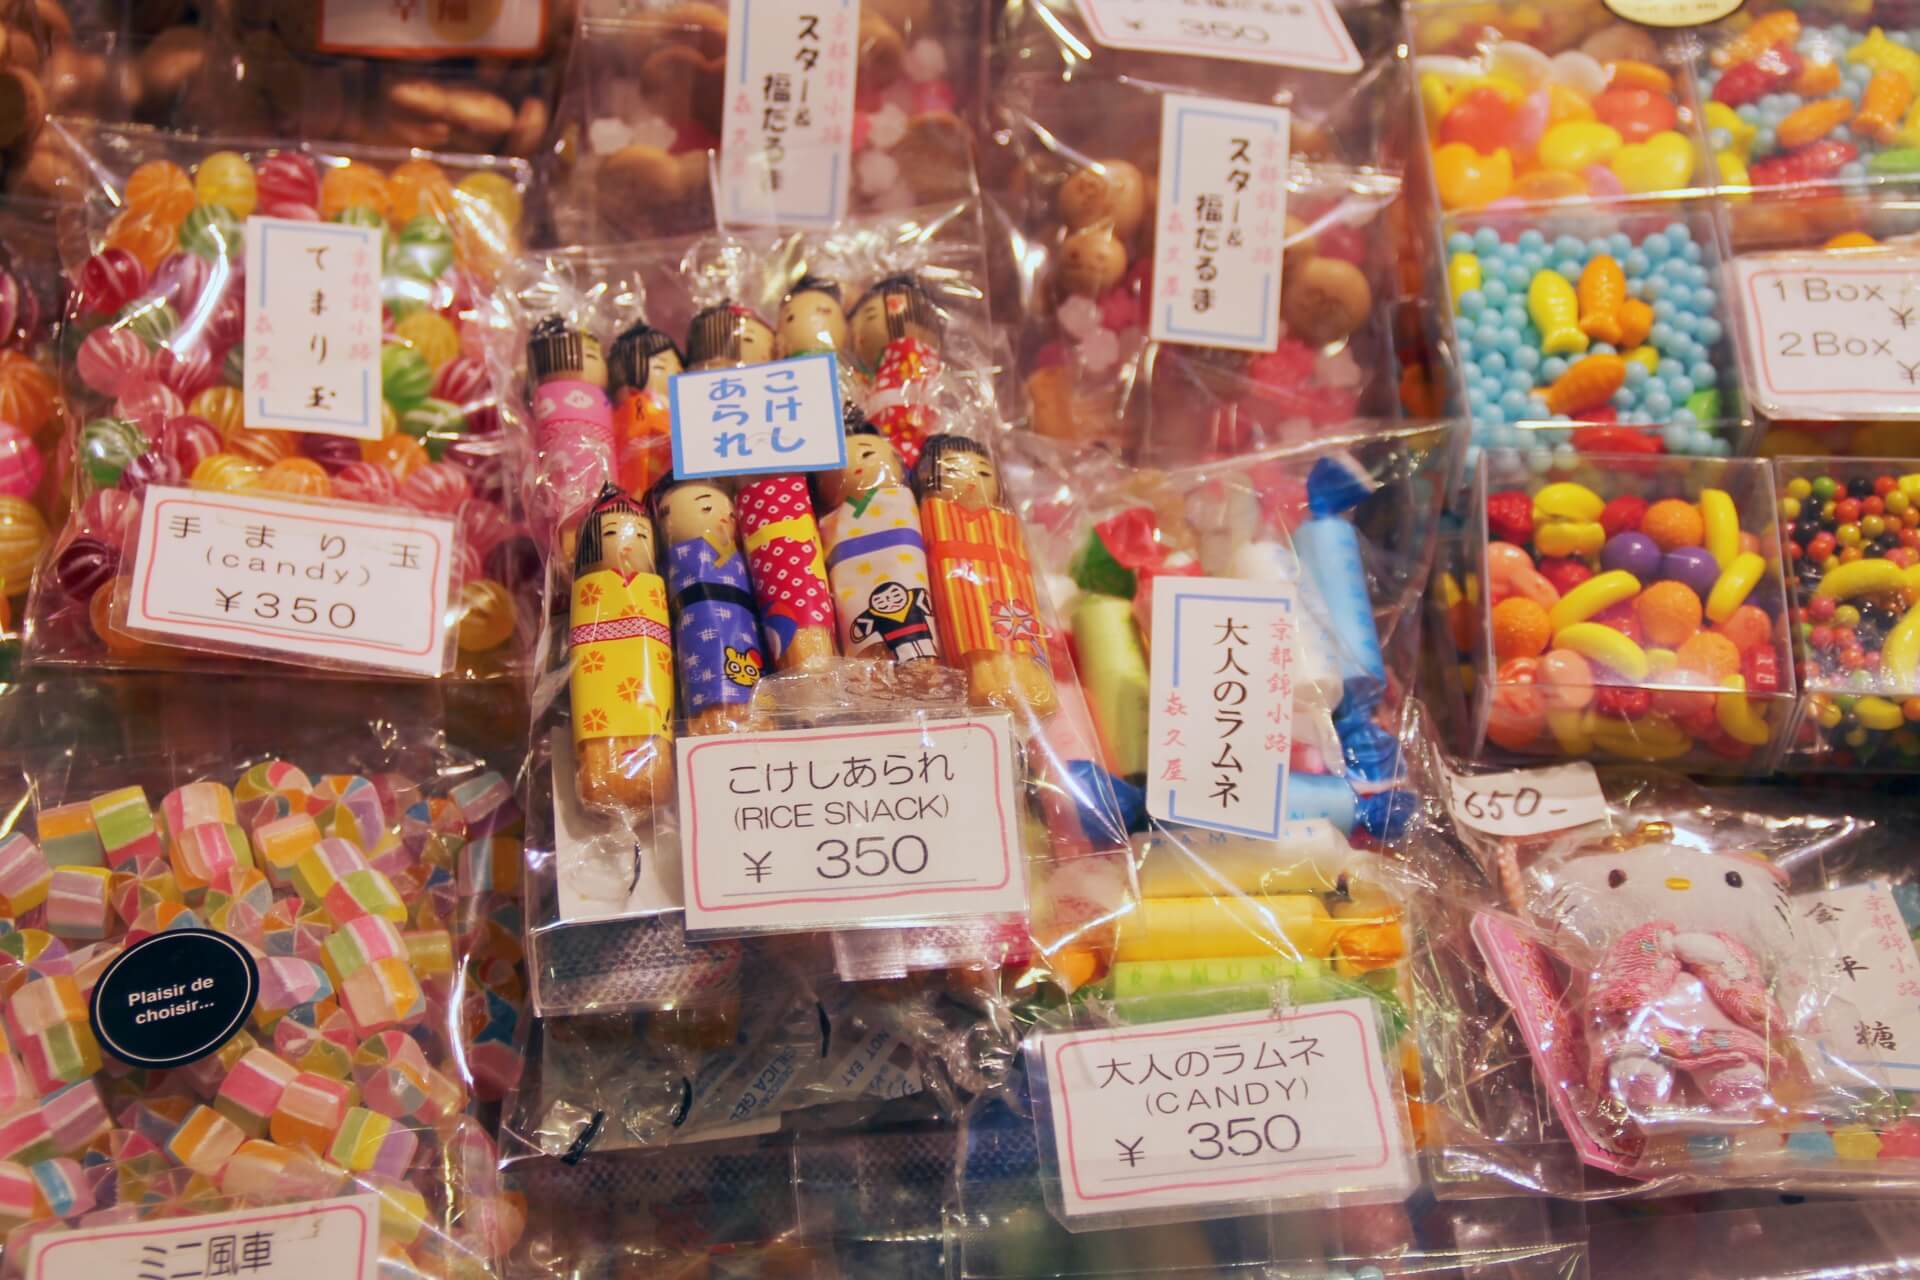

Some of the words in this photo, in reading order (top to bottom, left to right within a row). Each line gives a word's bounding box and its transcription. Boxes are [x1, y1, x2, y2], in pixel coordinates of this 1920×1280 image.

[1178, 18, 1270, 44] 350
[1773, 278, 1787, 302] 1
[1803, 277, 1885, 302] Box
[304, 245, 337, 410] てまり玉
[1778, 331, 1806, 357] 2
[1812, 331, 1893, 357] Box
[709, 377, 752, 457] あられ
[763, 370, 806, 453] こけし
[206, 545, 371, 587] (candy)
[1208, 616, 1251, 808] 大人のラムネ
[729, 751, 954, 794] こけしあられ
[733, 803, 815, 831] (RICE
[824, 794, 950, 825] SNACK)
[743, 850, 773, 883] ¥
[816, 834, 929, 880] 350
[127, 984, 188, 1007] Plaisir
[190, 977, 215, 992] de
[135, 1000, 216, 1025] choisir...
[841, 1059, 865, 1088] EAT
[1097, 1036, 1325, 1089] 大人のラムネ
[1146, 1077, 1310, 1116] (CANDY)
[1115, 1136, 1145, 1168] ¥
[1187, 1114, 1301, 1161] 350
